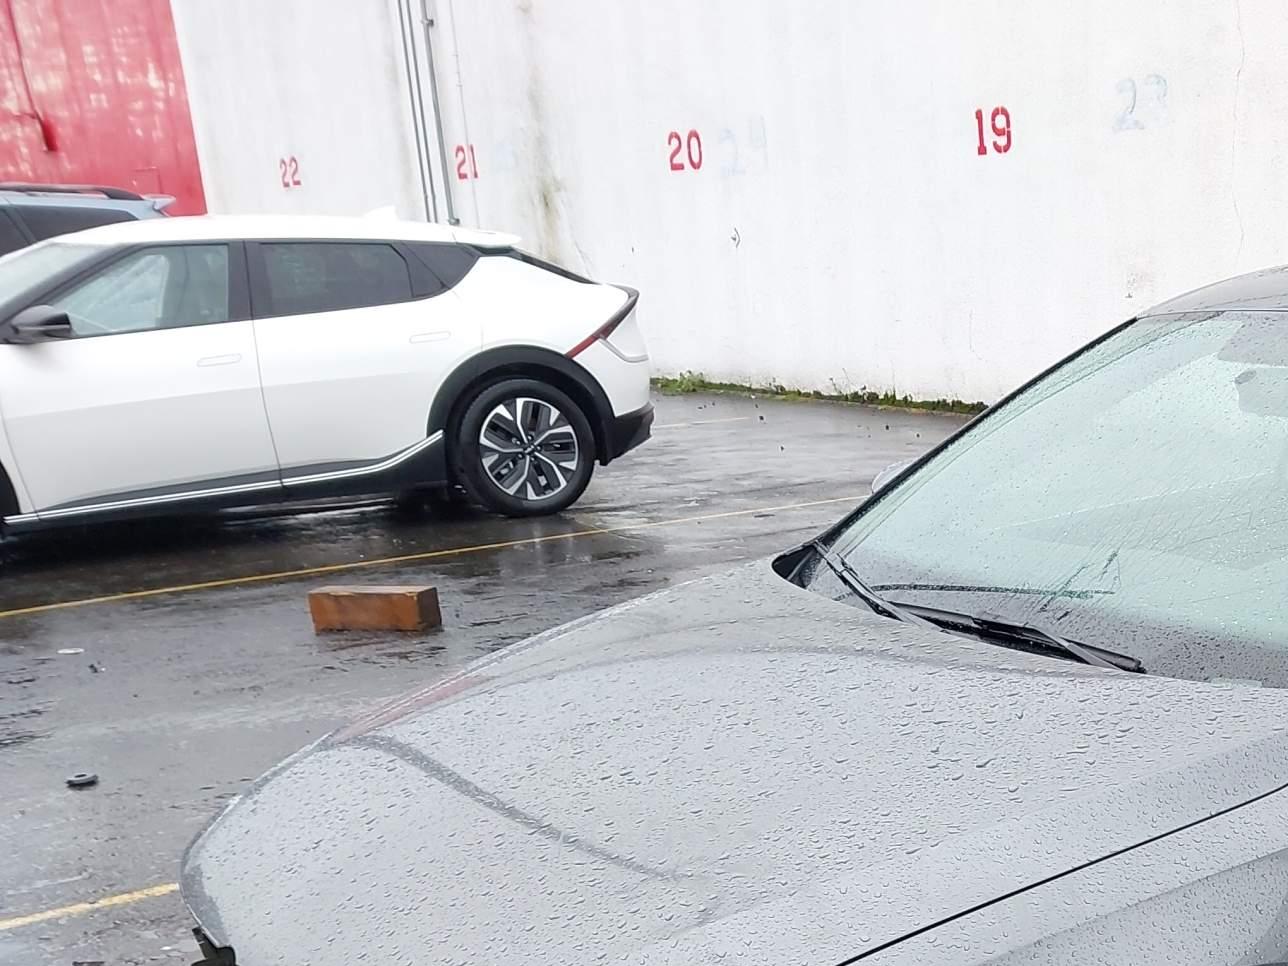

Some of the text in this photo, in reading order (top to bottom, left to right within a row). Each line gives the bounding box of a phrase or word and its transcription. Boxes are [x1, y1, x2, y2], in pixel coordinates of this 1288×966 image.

[975, 106, 1012, 155] 19
[455, 144, 478, 179] 21
[667, 129, 702, 171] 20
[279, 156, 302, 188] 22
